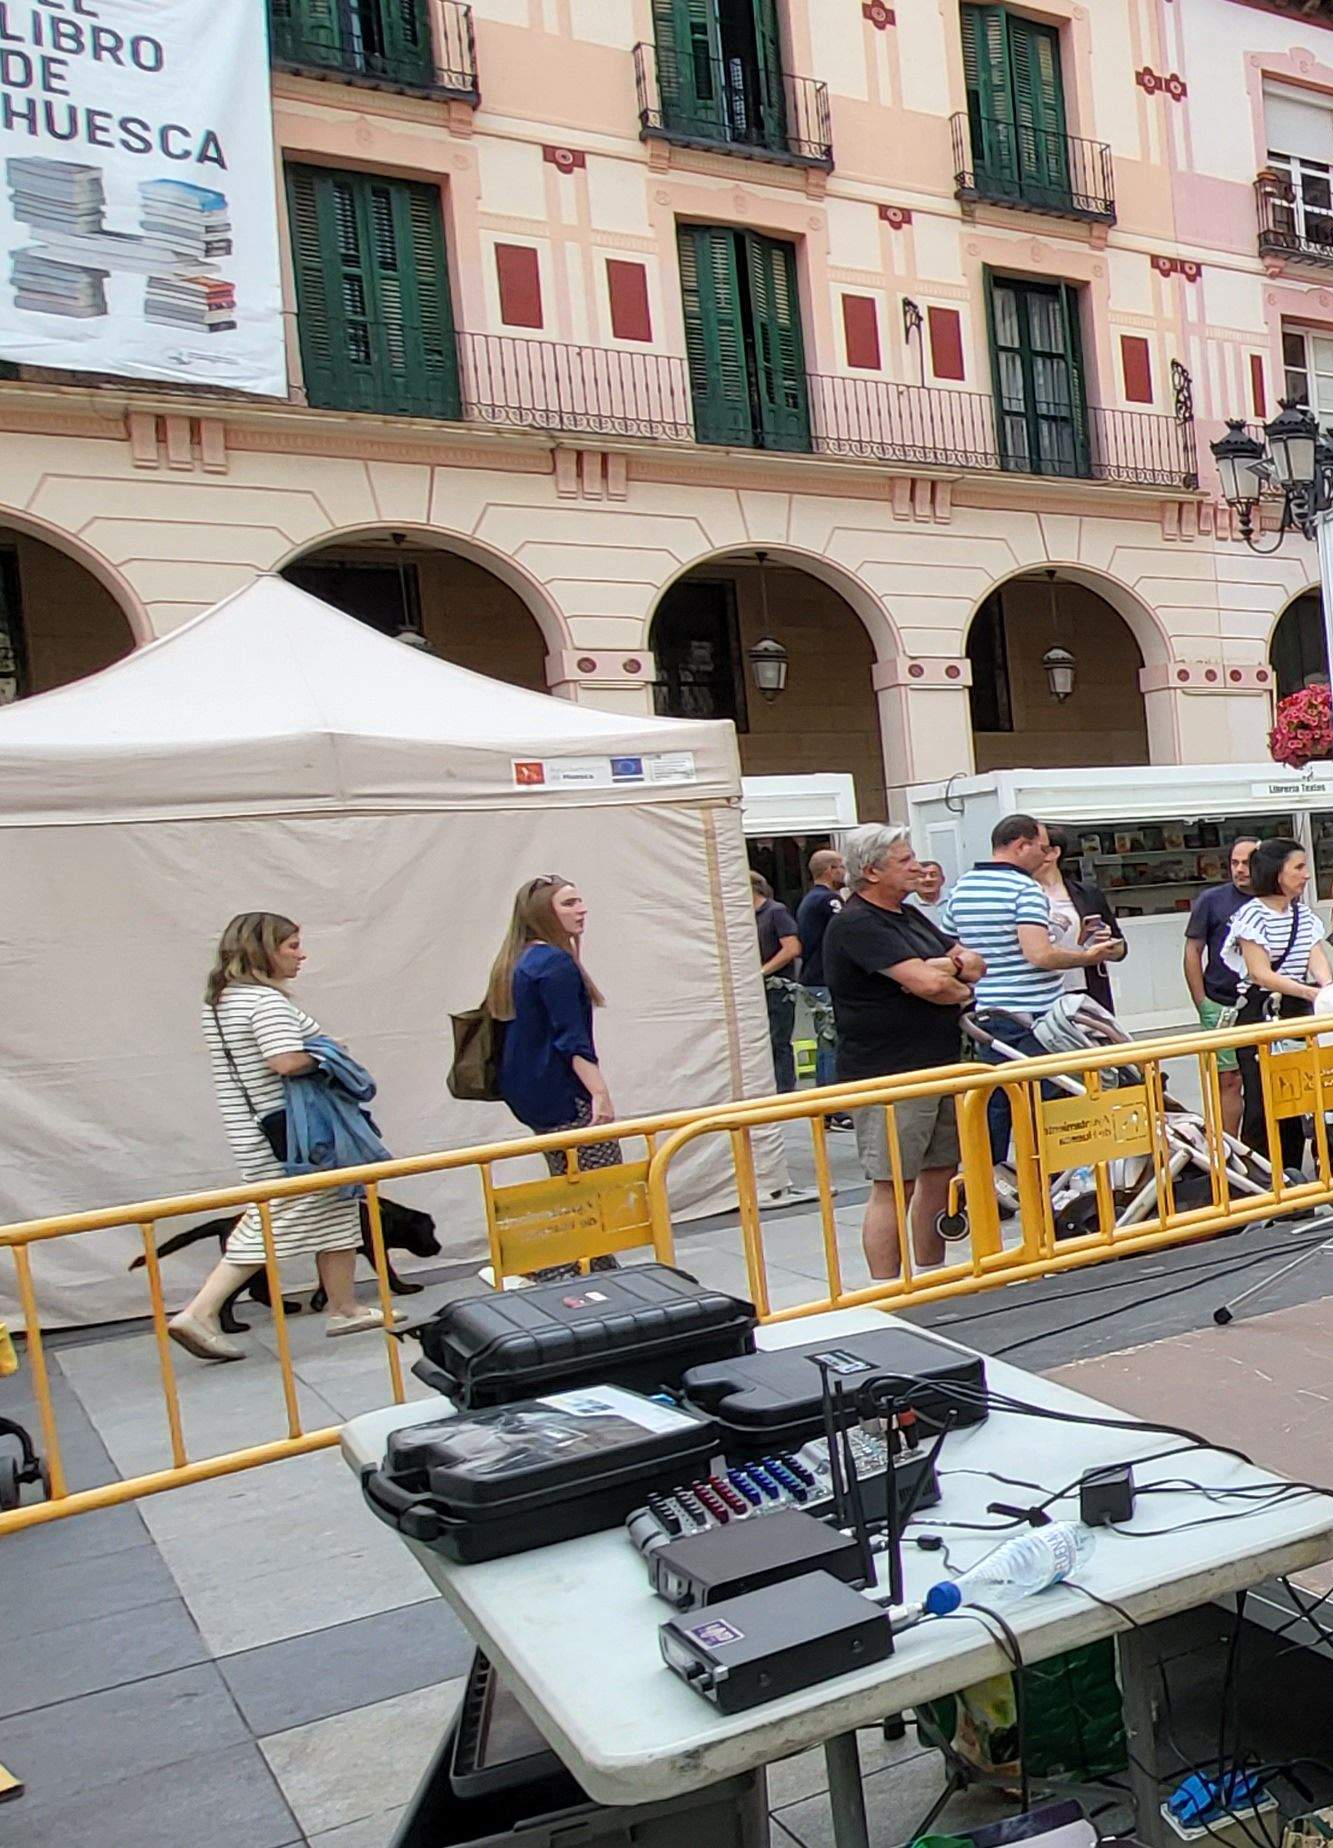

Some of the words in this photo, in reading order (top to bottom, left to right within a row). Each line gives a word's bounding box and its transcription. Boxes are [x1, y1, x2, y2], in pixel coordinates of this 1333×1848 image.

[0, 2, 164, 73] LIBRO
[0, 48, 70, 96] DE
[1, 91, 228, 170] HUESCA
